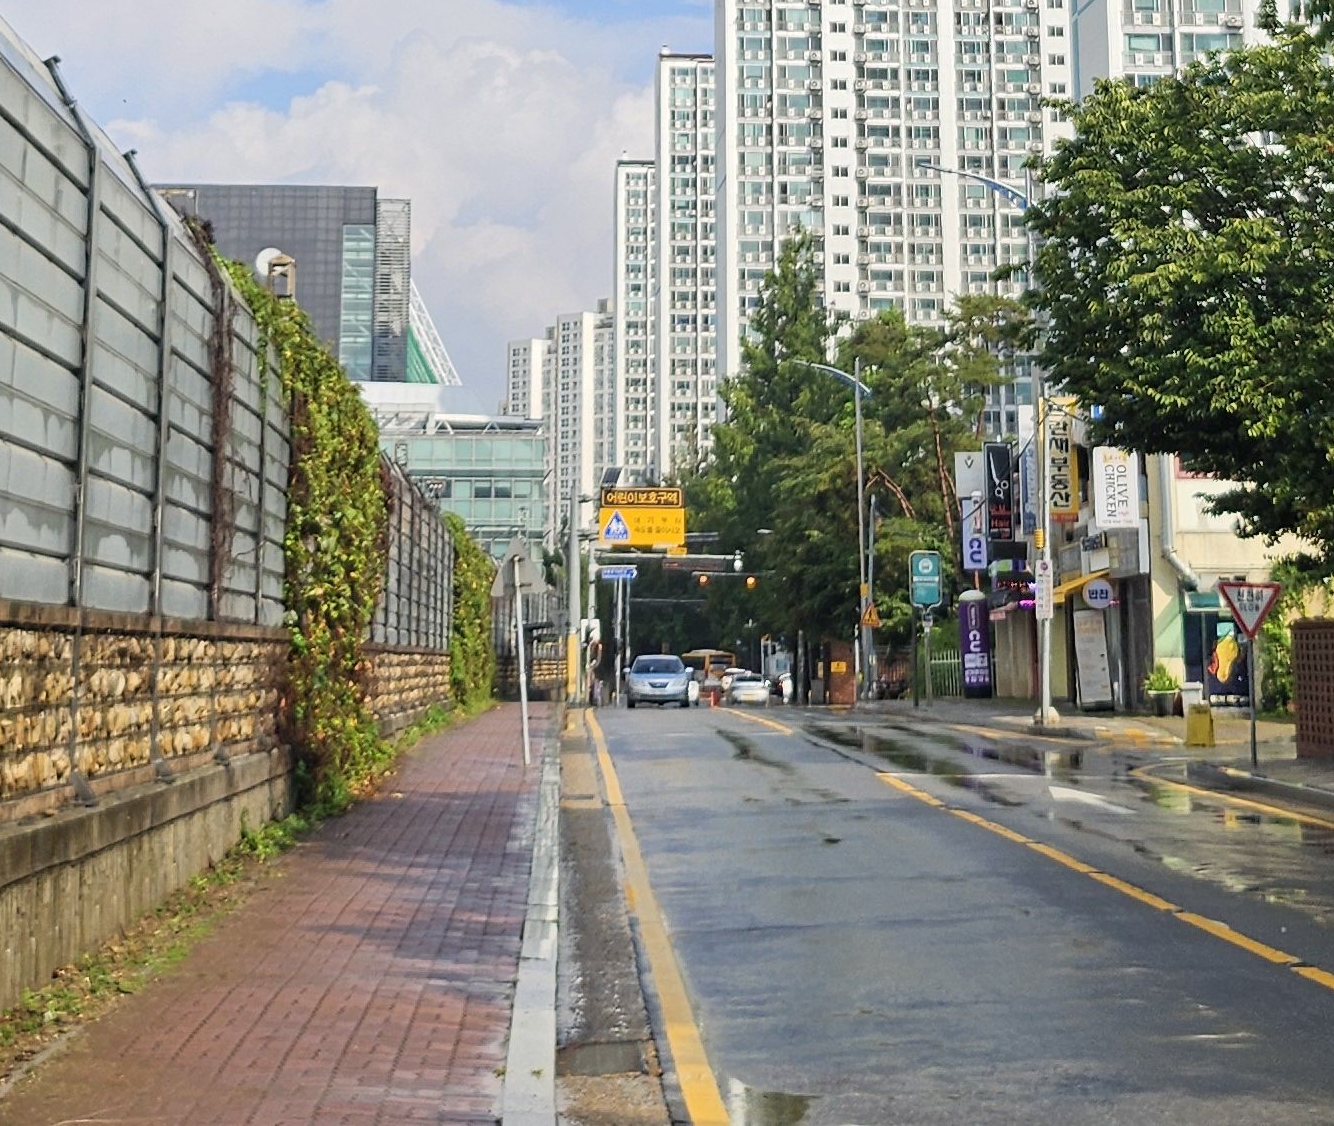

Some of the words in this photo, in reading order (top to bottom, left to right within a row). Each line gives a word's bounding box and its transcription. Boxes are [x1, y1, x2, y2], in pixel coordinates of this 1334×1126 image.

[607, 491, 678, 505] 어린이보호구역
[1104, 464, 1117, 518] CHICKEN
[1116, 464, 1130, 508] OLIVE
[969, 537, 982, 563] CU
[1088, 589, 1109, 600] 반찬
[969, 630, 981, 652] CU
